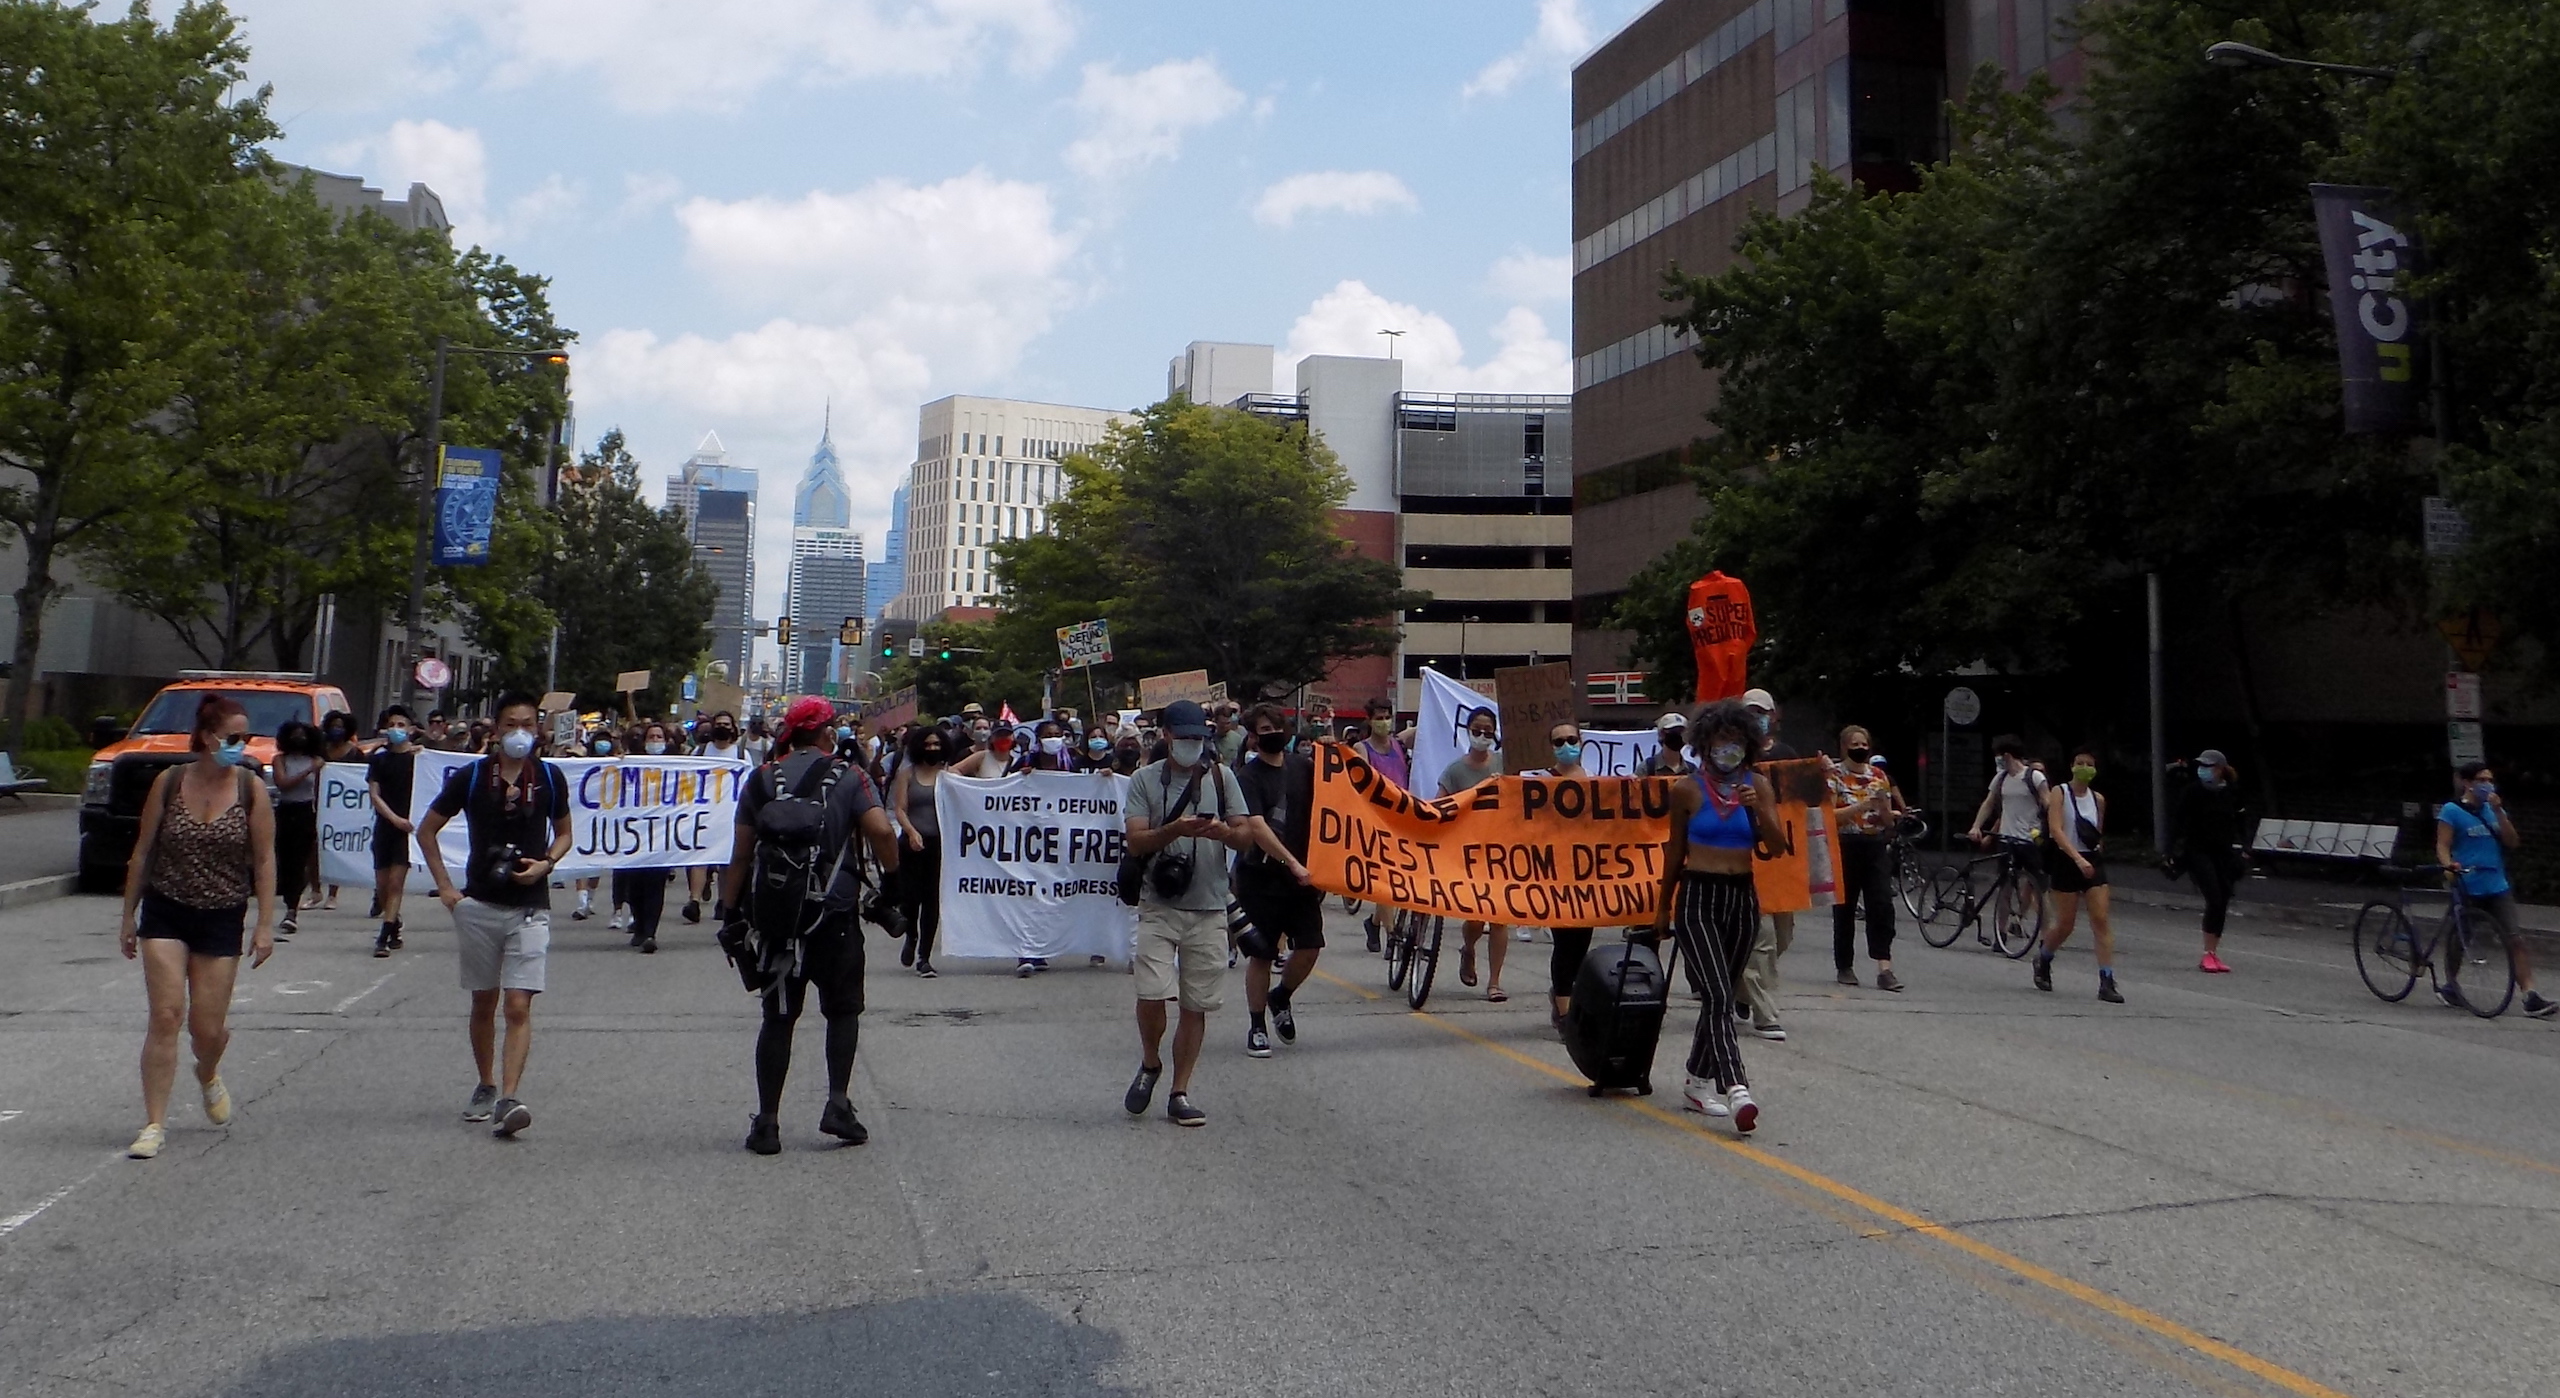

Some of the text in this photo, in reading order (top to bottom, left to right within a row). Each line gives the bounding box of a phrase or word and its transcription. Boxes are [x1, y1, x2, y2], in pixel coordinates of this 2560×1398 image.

[1069, 627, 1103, 644] DEFUND
[1071, 642, 1103, 659] POLICE
[1499, 667, 1567, 696] DEFUND
[1501, 699, 1573, 727] DISBAND
[579, 765, 745, 810] COMMUNITY
[1322, 745, 1459, 824] POLICE
[1522, 779, 1670, 820] POLLU
[985, 796, 1117, 815] DIVEST DEFUND
[322, 823, 372, 852] PennP
[577, 811, 710, 856] JUSTICE
[960, 821, 1059, 864] POLICE
[1320, 807, 1440, 875] DIVEST
[1463, 844, 1558, 883] FROM
[1572, 843, 1659, 882] DEST
[958, 877, 1119, 898] REINVEST REDRESS
[1345, 855, 1662, 922] OF BLACK COMMUNI
